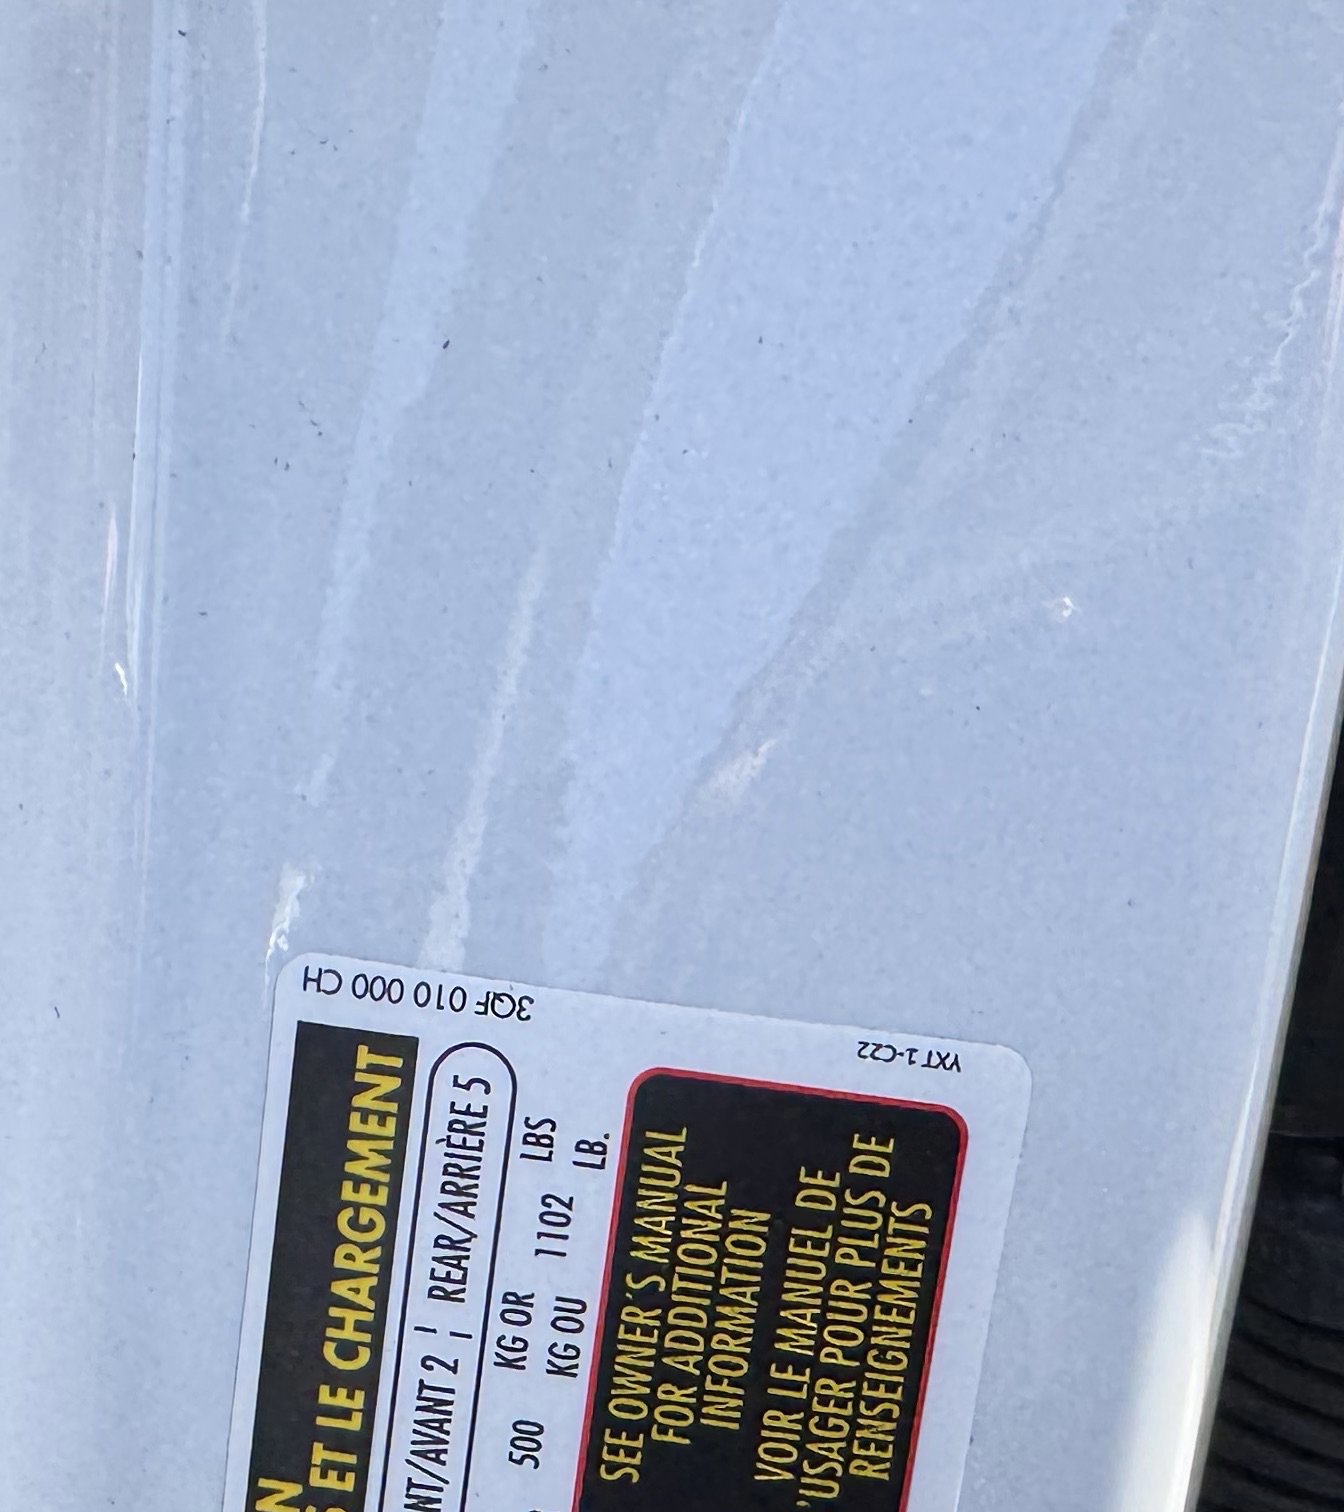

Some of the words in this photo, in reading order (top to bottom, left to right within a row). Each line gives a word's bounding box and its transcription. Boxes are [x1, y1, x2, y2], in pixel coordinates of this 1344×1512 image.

[301, 964, 344, 997] CH
[350, 972, 406, 1006] 000
[412, 980, 468, 1014] 010
[473, 989, 536, 1023] 3QF
[451, 1073, 492, 1097] 5
[920, 1049, 962, 1074] YXT
[518, 1115, 558, 1163] LBS
[571, 1132, 611, 1171] LB.
[847, 1135, 895, 1179] DE
[321, 1043, 405, 1372] CHARGEMENT
[426, 1099, 490, 1304] REAR/ARRIÈRE
[793, 1167, 842, 1212] DE
[533, 1192, 575, 1258] 1102
[833, 1189, 887, 1269] PLUS
[660, 1182, 729, 1376] ADDITIONAL
[773, 1223, 834, 1356] MANUEL
[498, 1290, 536, 1328] OR
[549, 1294, 589, 1335] OU
[598, 1428, 645, 1483] SEE
[628, 1127, 688, 1265] MANUAL
[699, 1207, 770, 1431] INFORMATION
[818, 1277, 874, 1368] POUR
[419, 1353, 460, 1376] 2
[492, 1333, 530, 1372] KG
[544, 1340, 582, 1379] KG
[847, 1202, 934, 1481] RENSEIGNEMENTS
[766, 1364, 812, 1401] LE
[314, 1383, 366, 1433] LE
[649, 1382, 697, 1446] FOR
[307, 1440, 359, 1493] ET
[507, 1418, 546, 1471] 500
[753, 1408, 805, 1482] VOIR
